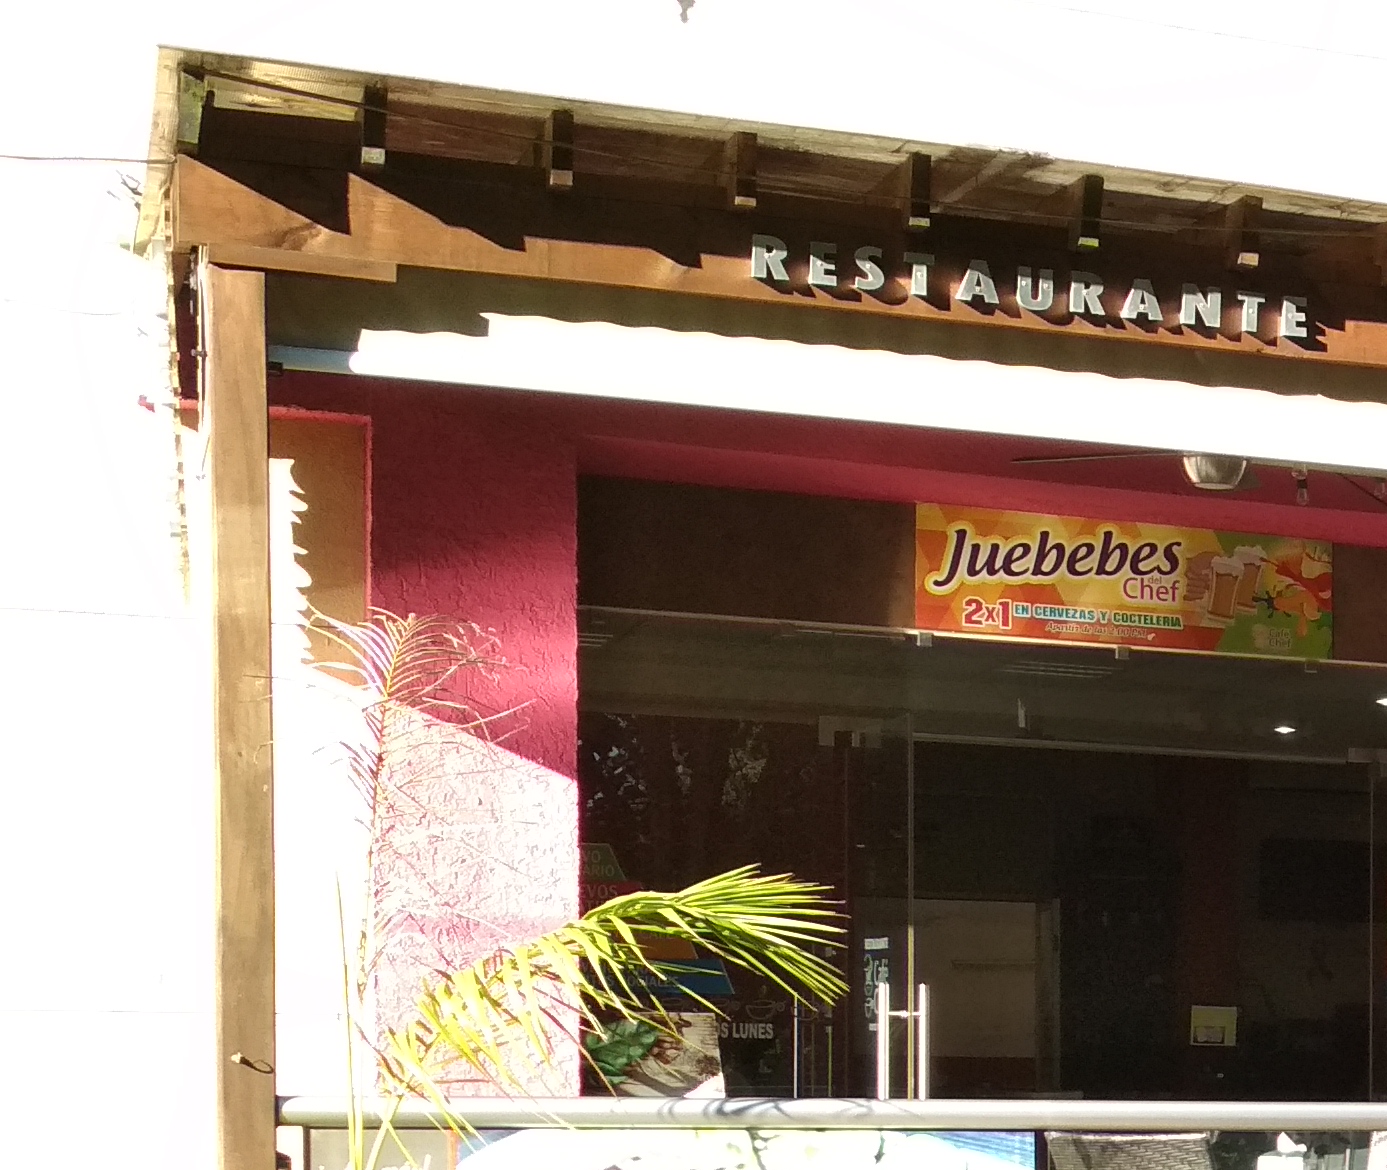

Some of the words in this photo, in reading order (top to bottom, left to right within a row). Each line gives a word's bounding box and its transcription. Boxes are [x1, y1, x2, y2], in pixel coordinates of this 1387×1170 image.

[751, 233, 1308, 338] RESTAURANTE
[935, 528, 1183, 589] Juebebes
[1124, 577, 1180, 602] Chef
[963, 597, 1012, 628] 2x1
[1015, 603, 1030, 616] EN
[1034, 605, 1095, 622] CERVEZAS
[1099, 610, 1109, 622] Y
[1113, 612, 1182, 628] COCTELERIA
[732, 1022, 774, 1039] LUNES
